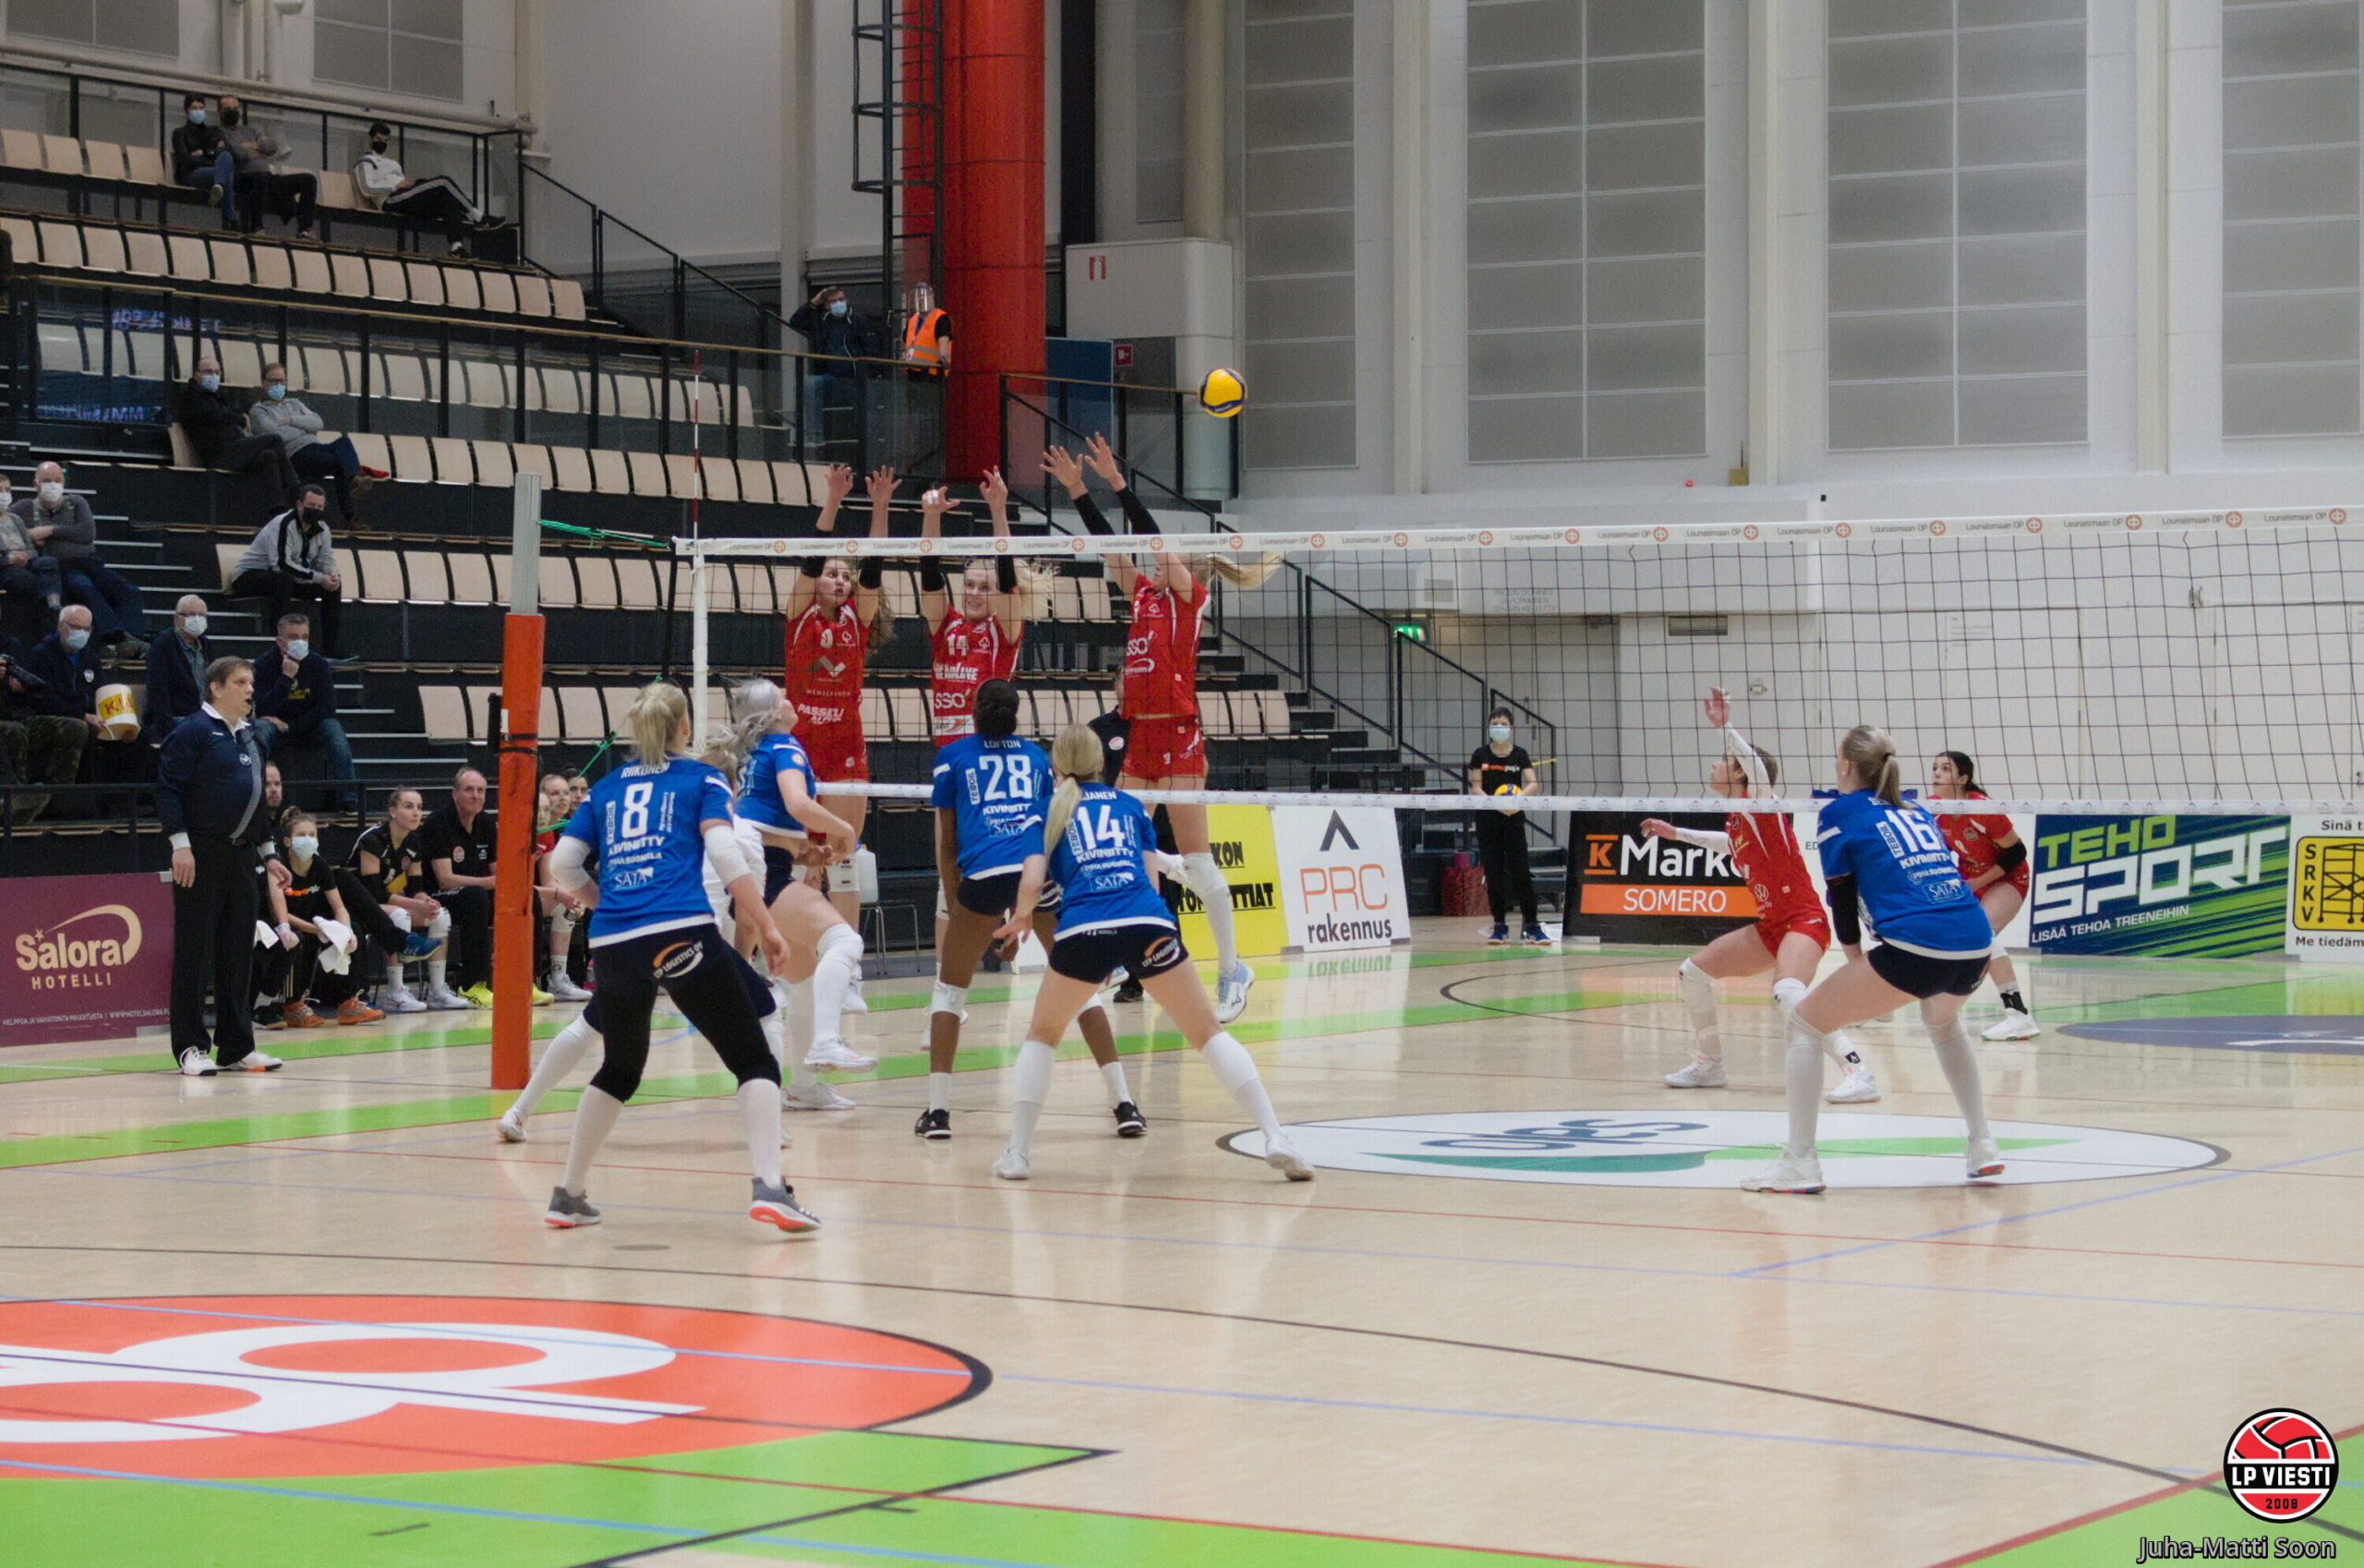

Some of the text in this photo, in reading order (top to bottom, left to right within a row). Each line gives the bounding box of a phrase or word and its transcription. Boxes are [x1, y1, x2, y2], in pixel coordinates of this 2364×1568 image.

[820, 628, 833, 648] 9
[947, 633, 968, 656] 14
[979, 754, 1032, 802] 28
[621, 781, 654, 838] 8
[1077, 805, 1125, 850] 14
[2322, 820, 2353, 831] Sinä
[1884, 809, 1942, 852] 16
[2037, 815, 2177, 868] TEHO
[1620, 834, 1749, 879] Mark
[2032, 826, 2286, 925] SPORT
[1300, 863, 1388, 913] PRC
[1623, 888, 1727, 913] SOMERO
[1308, 912, 1393, 944] rakennus
[2032, 905, 2190, 944] LISÄÄ TEHOA TREENEIHIN
[2296, 936, 2314, 947] Me
[15, 933, 122, 971] Salora
[31, 972, 111, 990] HOTELLI
